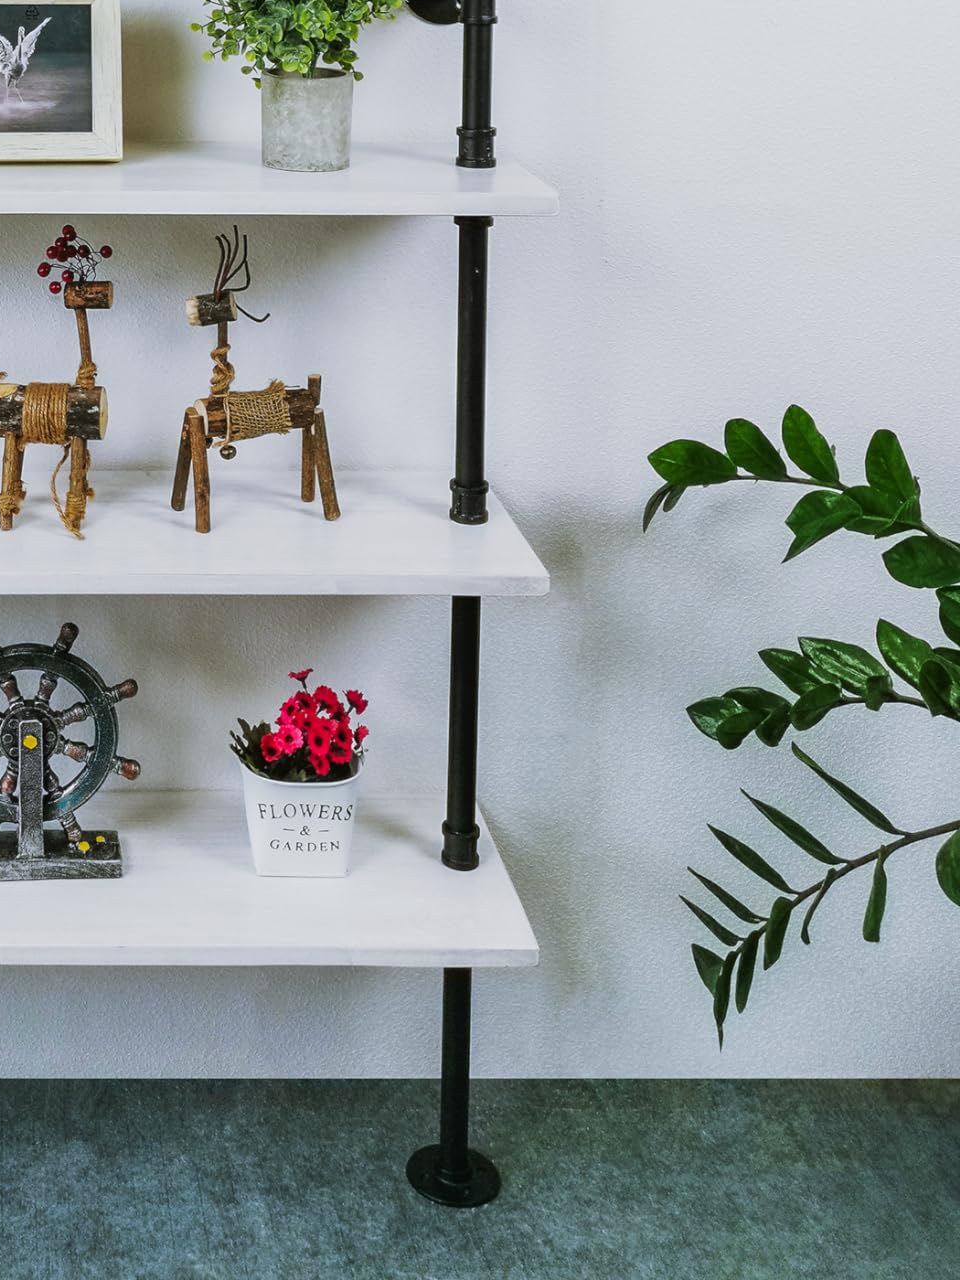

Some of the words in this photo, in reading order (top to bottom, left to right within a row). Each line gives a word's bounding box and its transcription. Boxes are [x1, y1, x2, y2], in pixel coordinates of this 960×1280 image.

[257, 803, 354, 821] FLOWERS
[299, 825, 311, 836] &
[269, 839, 341, 852] GARDEN
